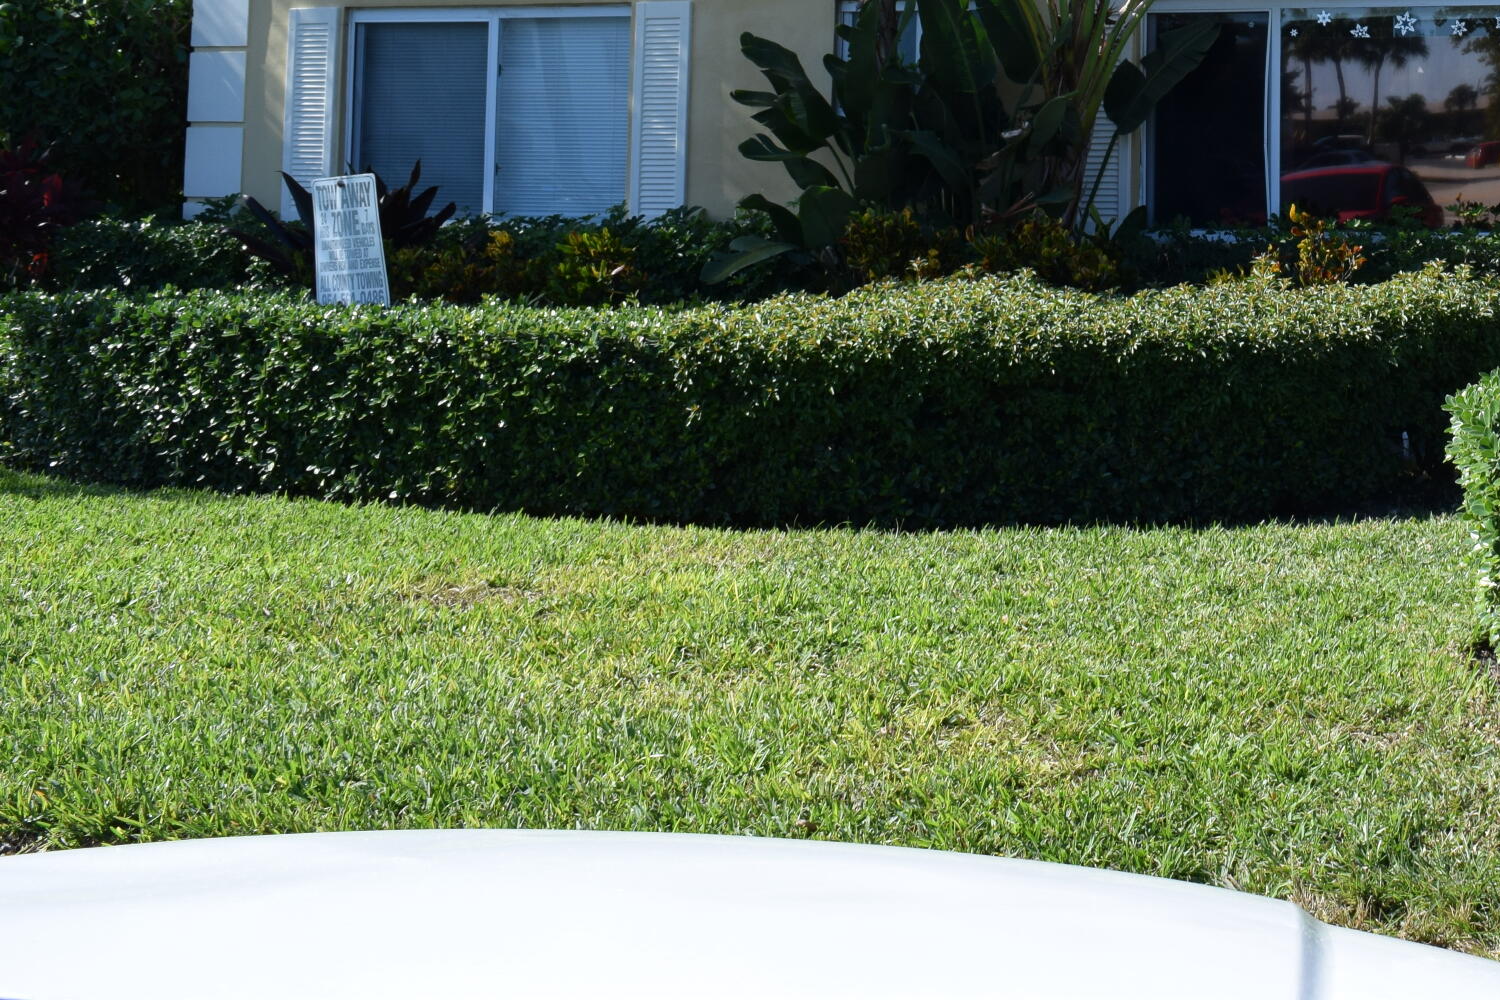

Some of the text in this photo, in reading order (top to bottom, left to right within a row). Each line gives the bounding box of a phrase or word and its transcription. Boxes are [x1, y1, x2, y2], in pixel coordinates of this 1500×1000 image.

[316, 181, 371, 211] TOW AWAY
[331, 210, 361, 237] ZONE
[361, 222, 375, 235] DAYS
[352, 236, 375, 248] VEHICLES
[360, 257, 382, 269] EXPENSE
[320, 270, 384, 292] ALL COUNTY TOWING
